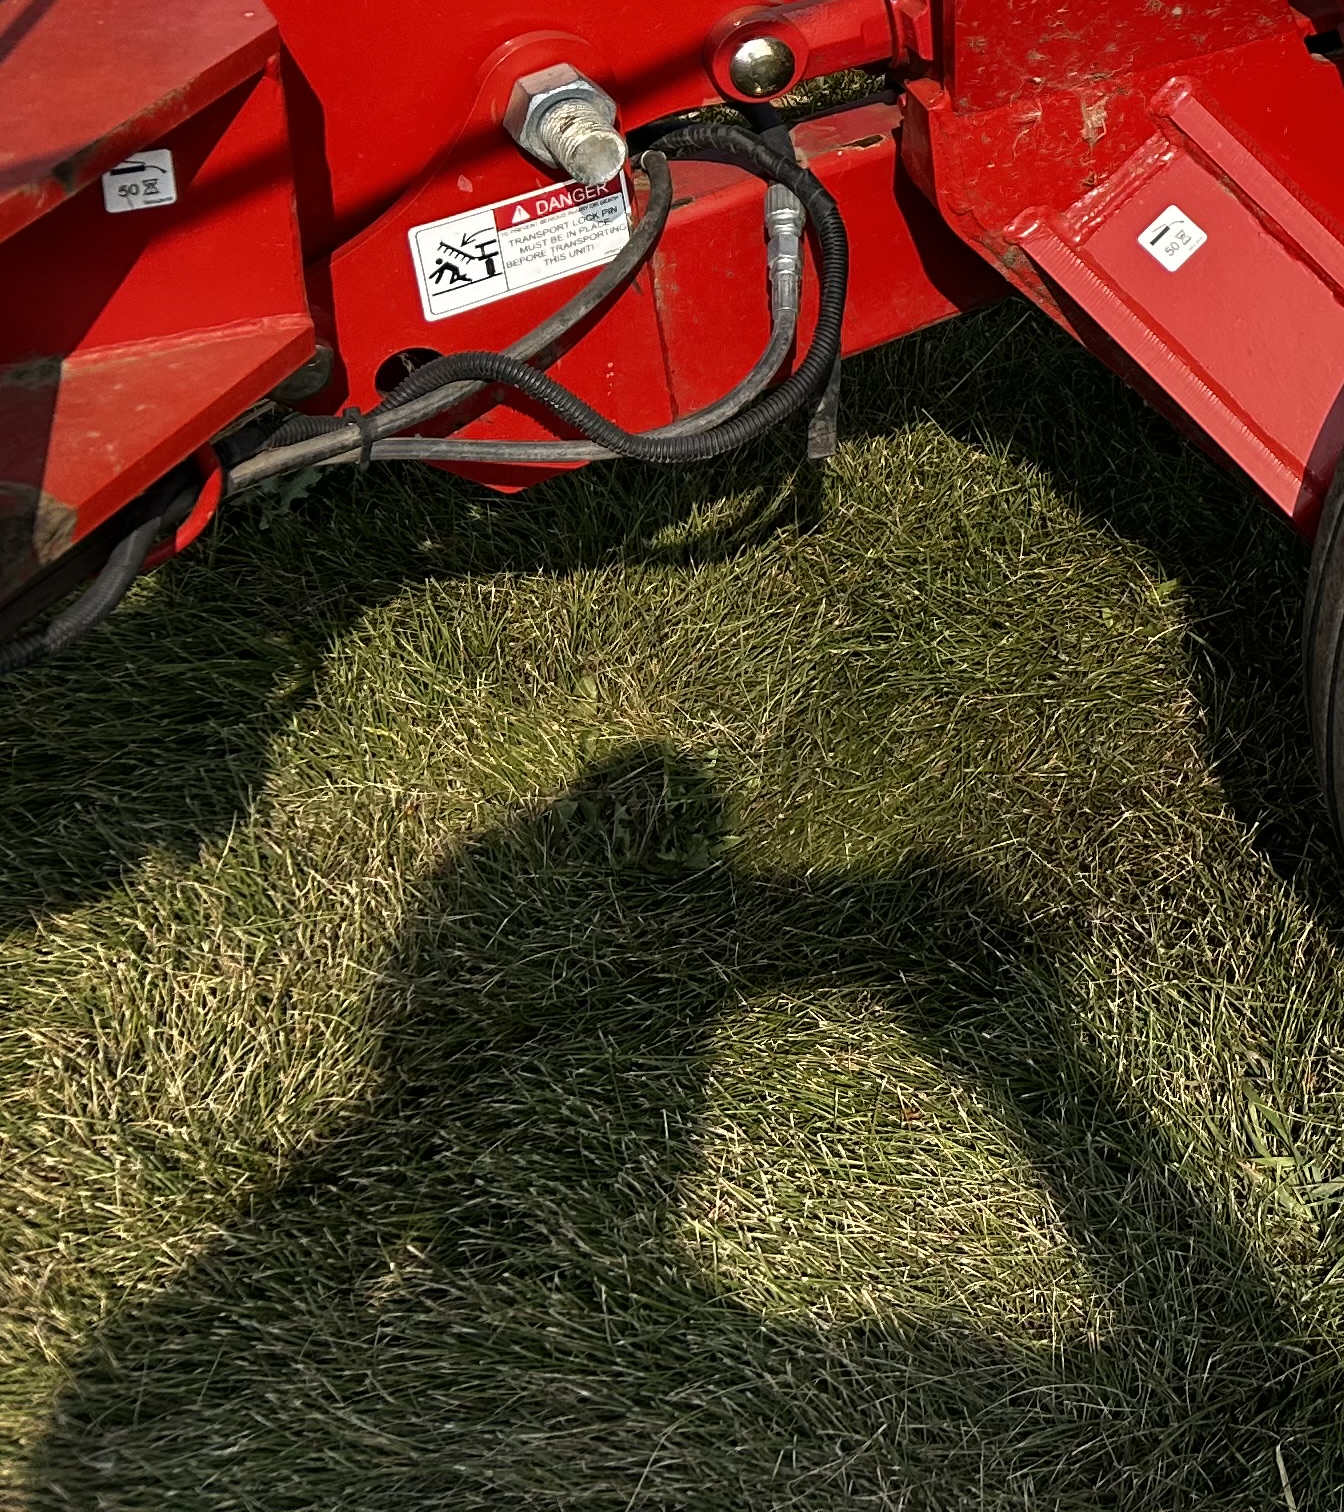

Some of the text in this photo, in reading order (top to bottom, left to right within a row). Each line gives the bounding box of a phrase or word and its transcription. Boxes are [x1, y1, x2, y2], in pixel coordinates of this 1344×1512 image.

[536, 187, 609, 215] DANGER
[507, 205, 617, 247] TRANSPORT LOCK PIN
[518, 217, 610, 254] MUST BE IN PLACE
[505, 222, 627, 268] BEFORE TRANSPORTING
[543, 253, 566, 266] THIS
[1165, 242, 1180, 256] 50
